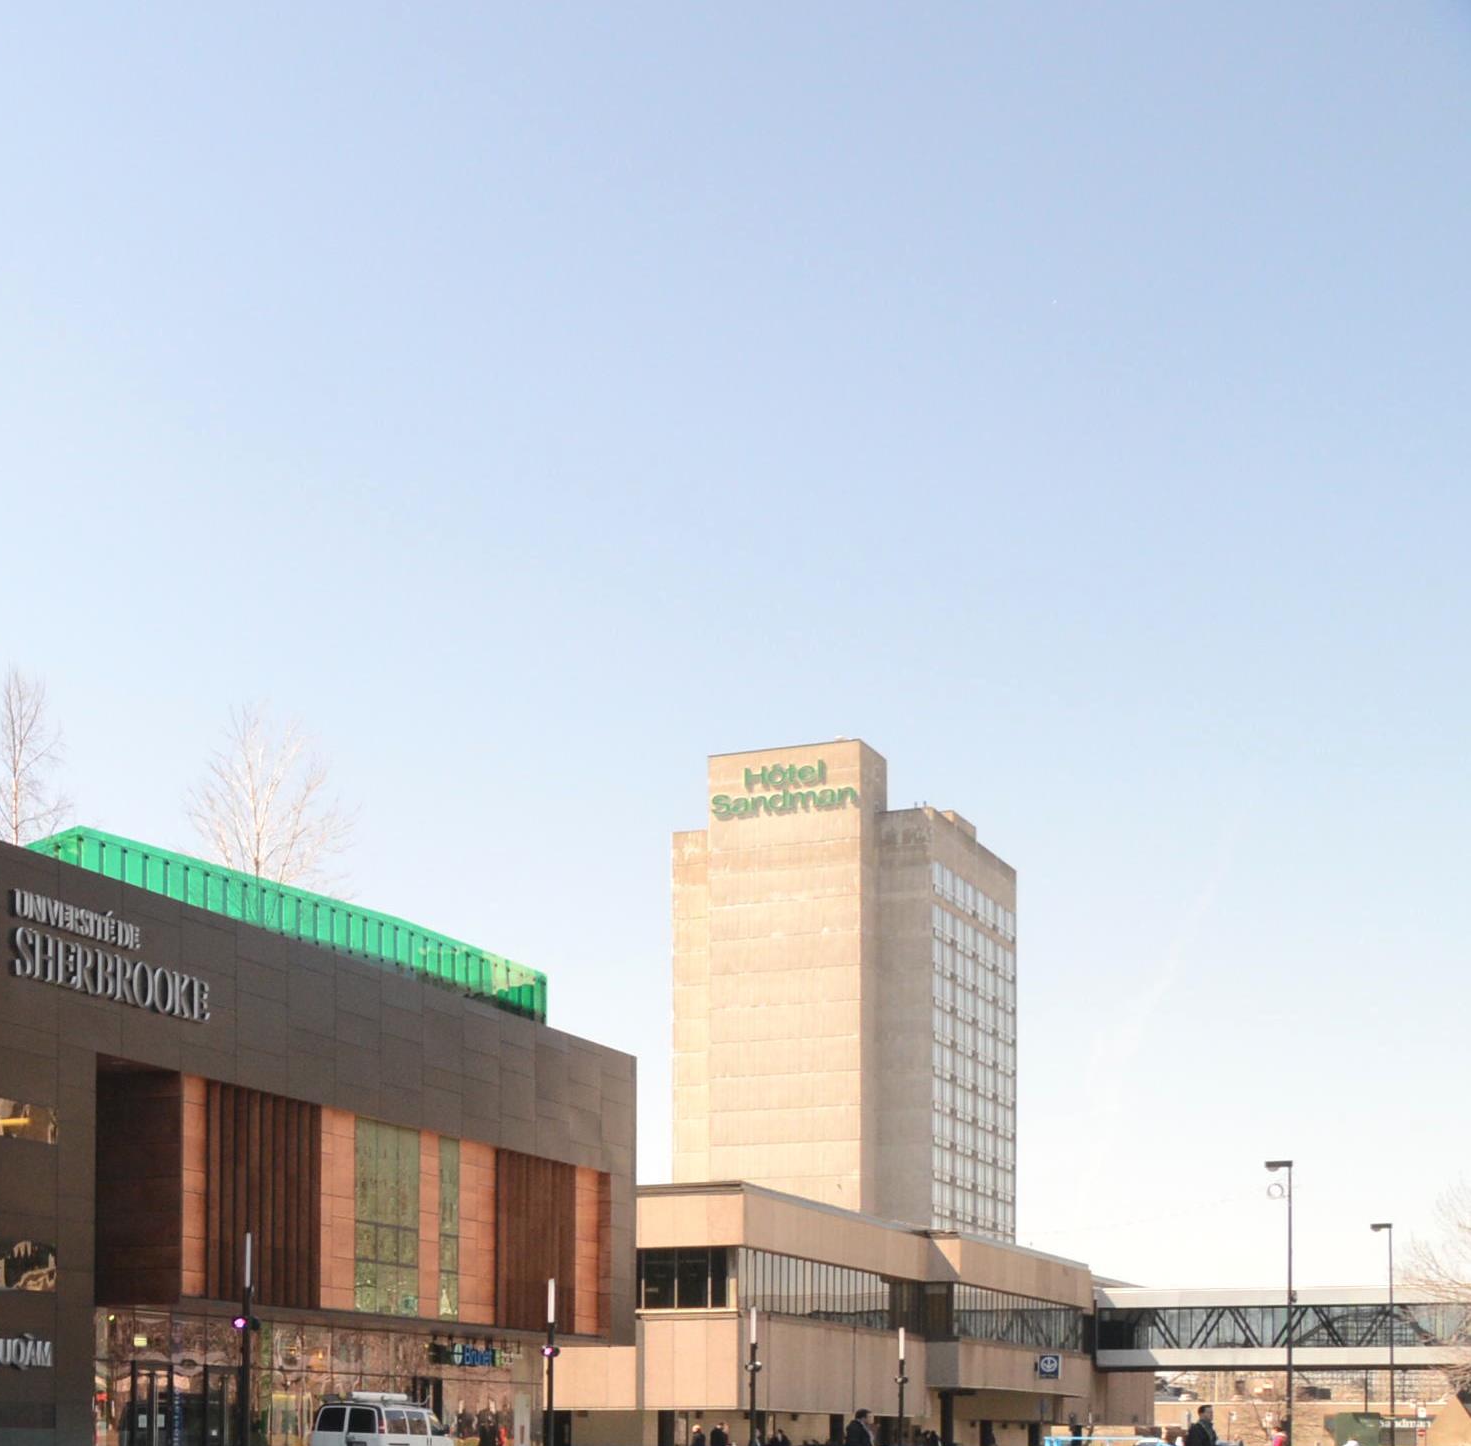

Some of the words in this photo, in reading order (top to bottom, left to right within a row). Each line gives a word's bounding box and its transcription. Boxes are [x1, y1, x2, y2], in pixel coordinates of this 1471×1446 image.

[744, 759, 827, 788] Hôtel
[711, 786, 858, 819] Sandman
[13, 888, 117, 944] UNIVERSITÉ
[117, 919, 141, 949] DE
[14, 926, 211, 1023] SHERBROOKE
